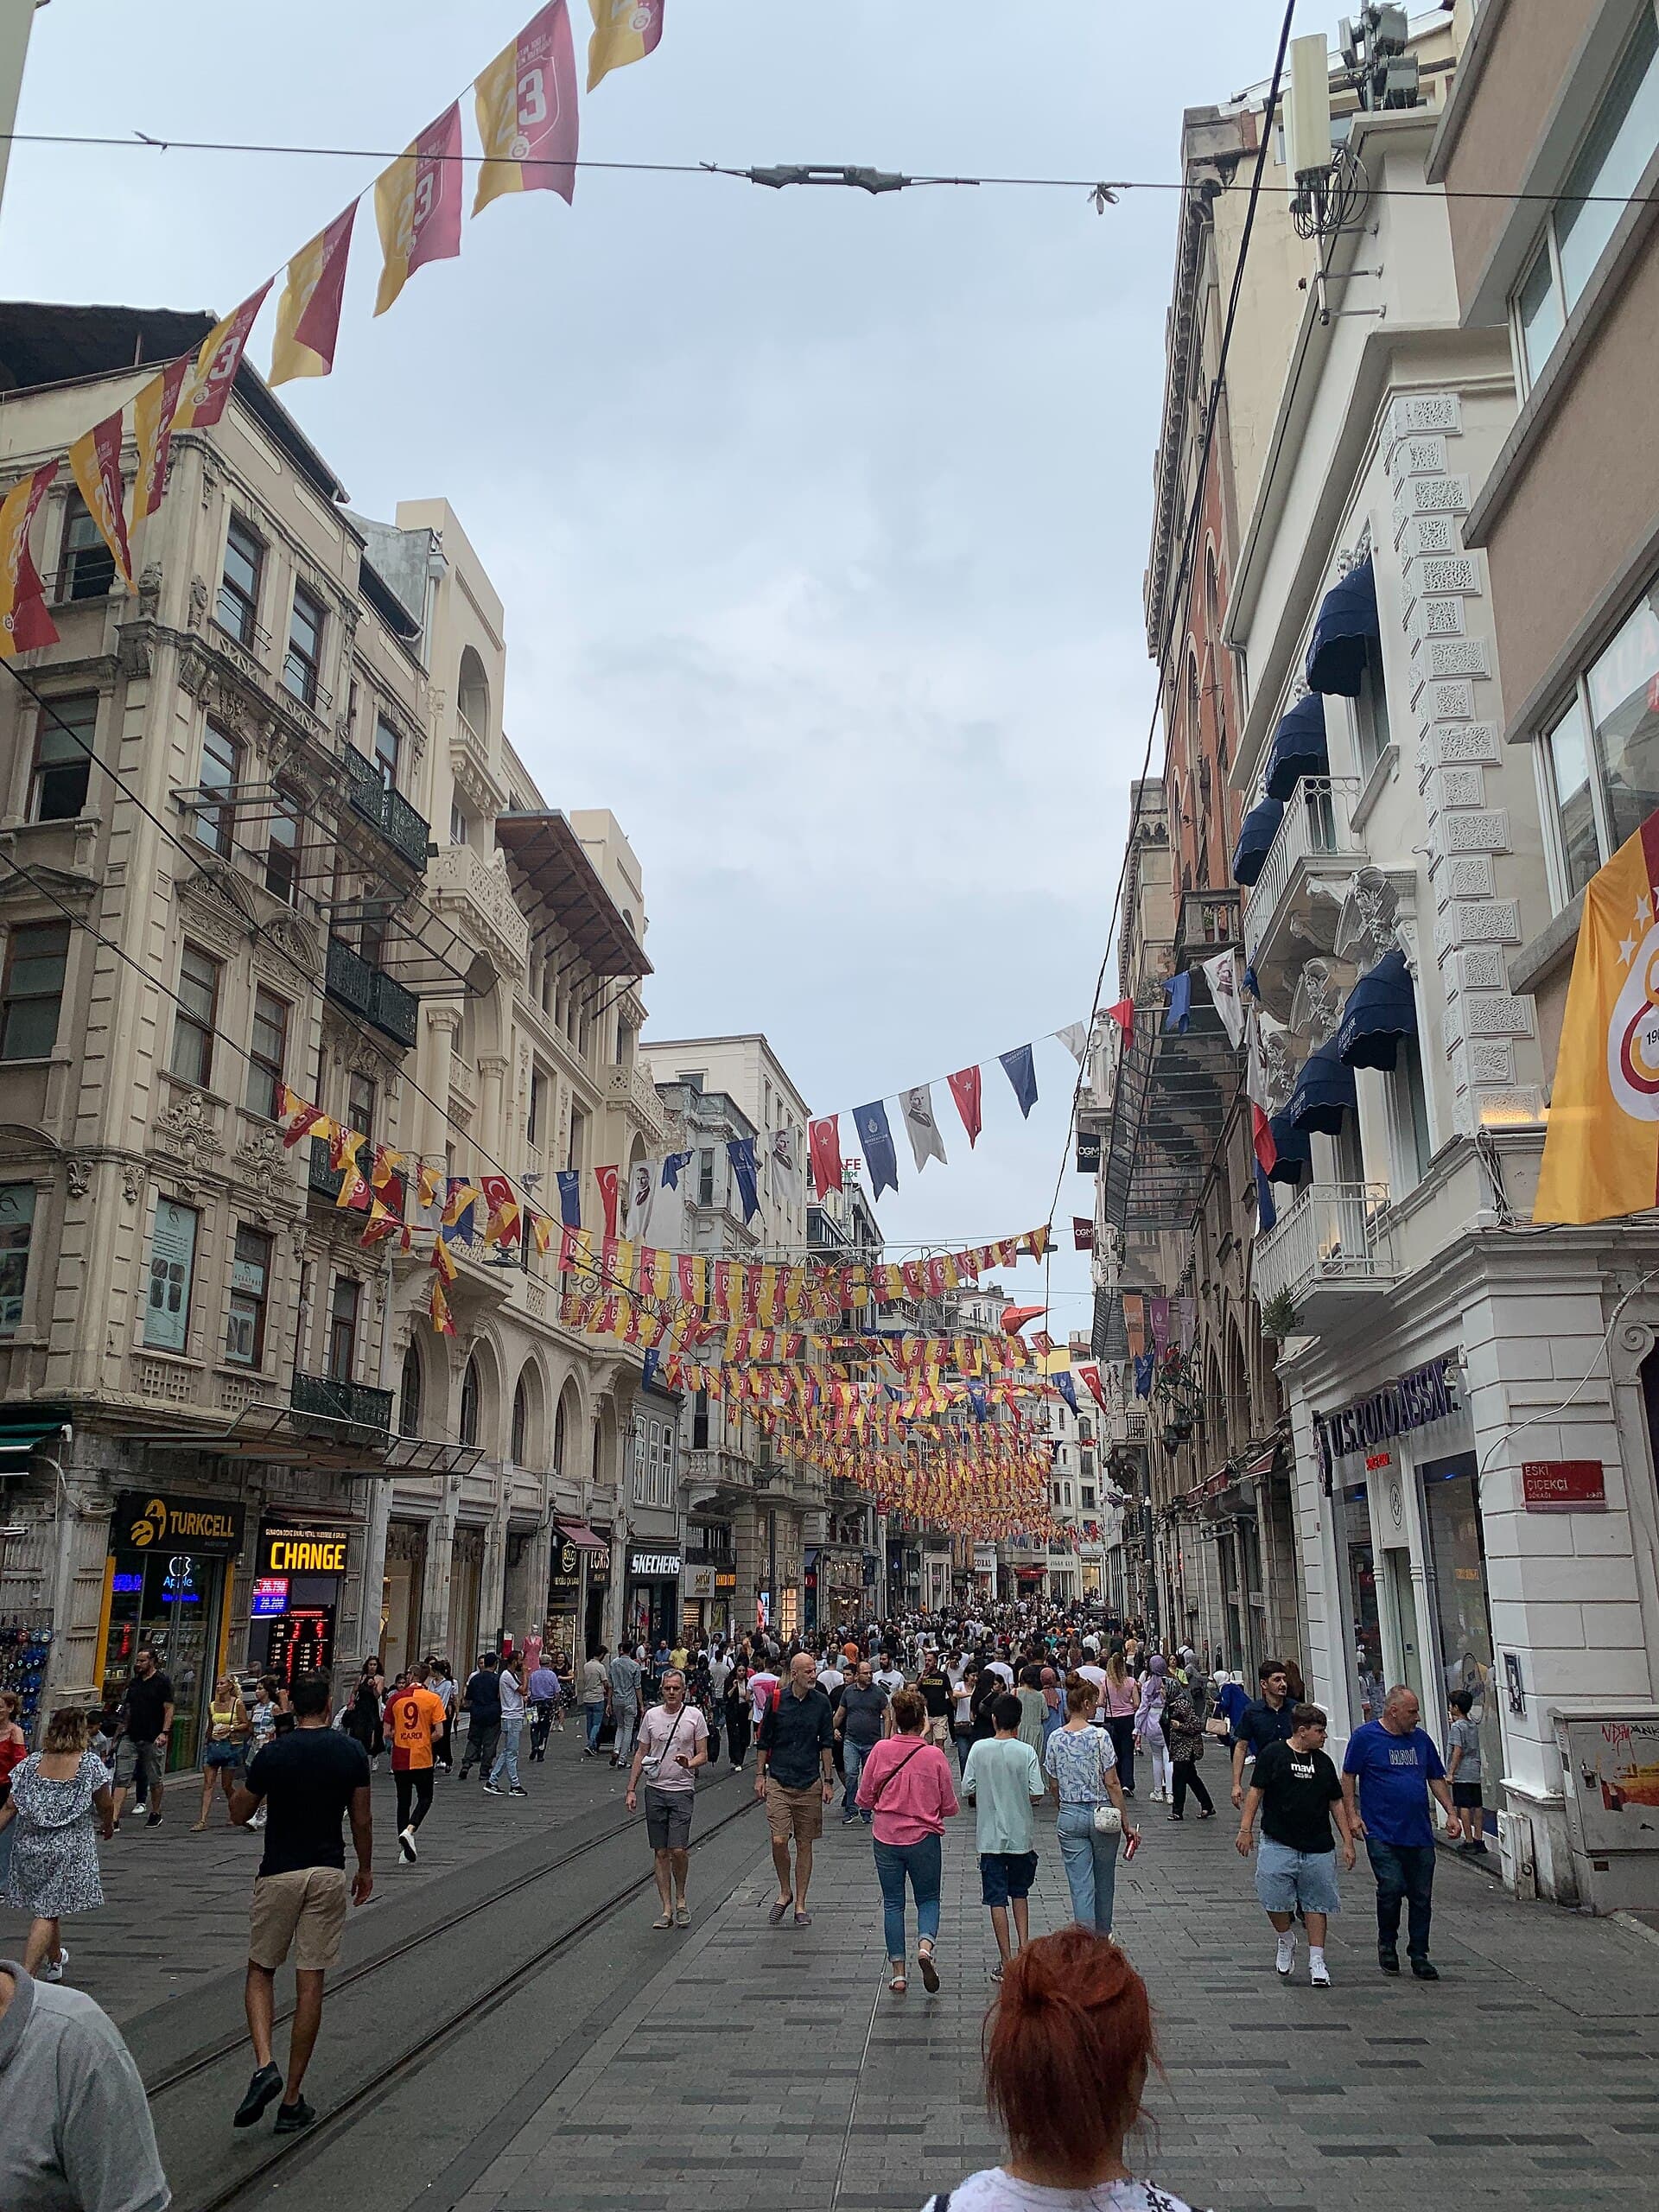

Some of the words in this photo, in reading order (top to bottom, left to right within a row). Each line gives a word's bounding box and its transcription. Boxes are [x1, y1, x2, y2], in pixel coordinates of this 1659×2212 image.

[170, 1511, 234, 1537] TURKCELL
[270, 1541, 346, 1570] CHANGE
[631, 1554, 681, 1573] SKECHERS
[404, 1702, 418, 1730] 9
[1290, 1763, 1315, 1773] mavi
